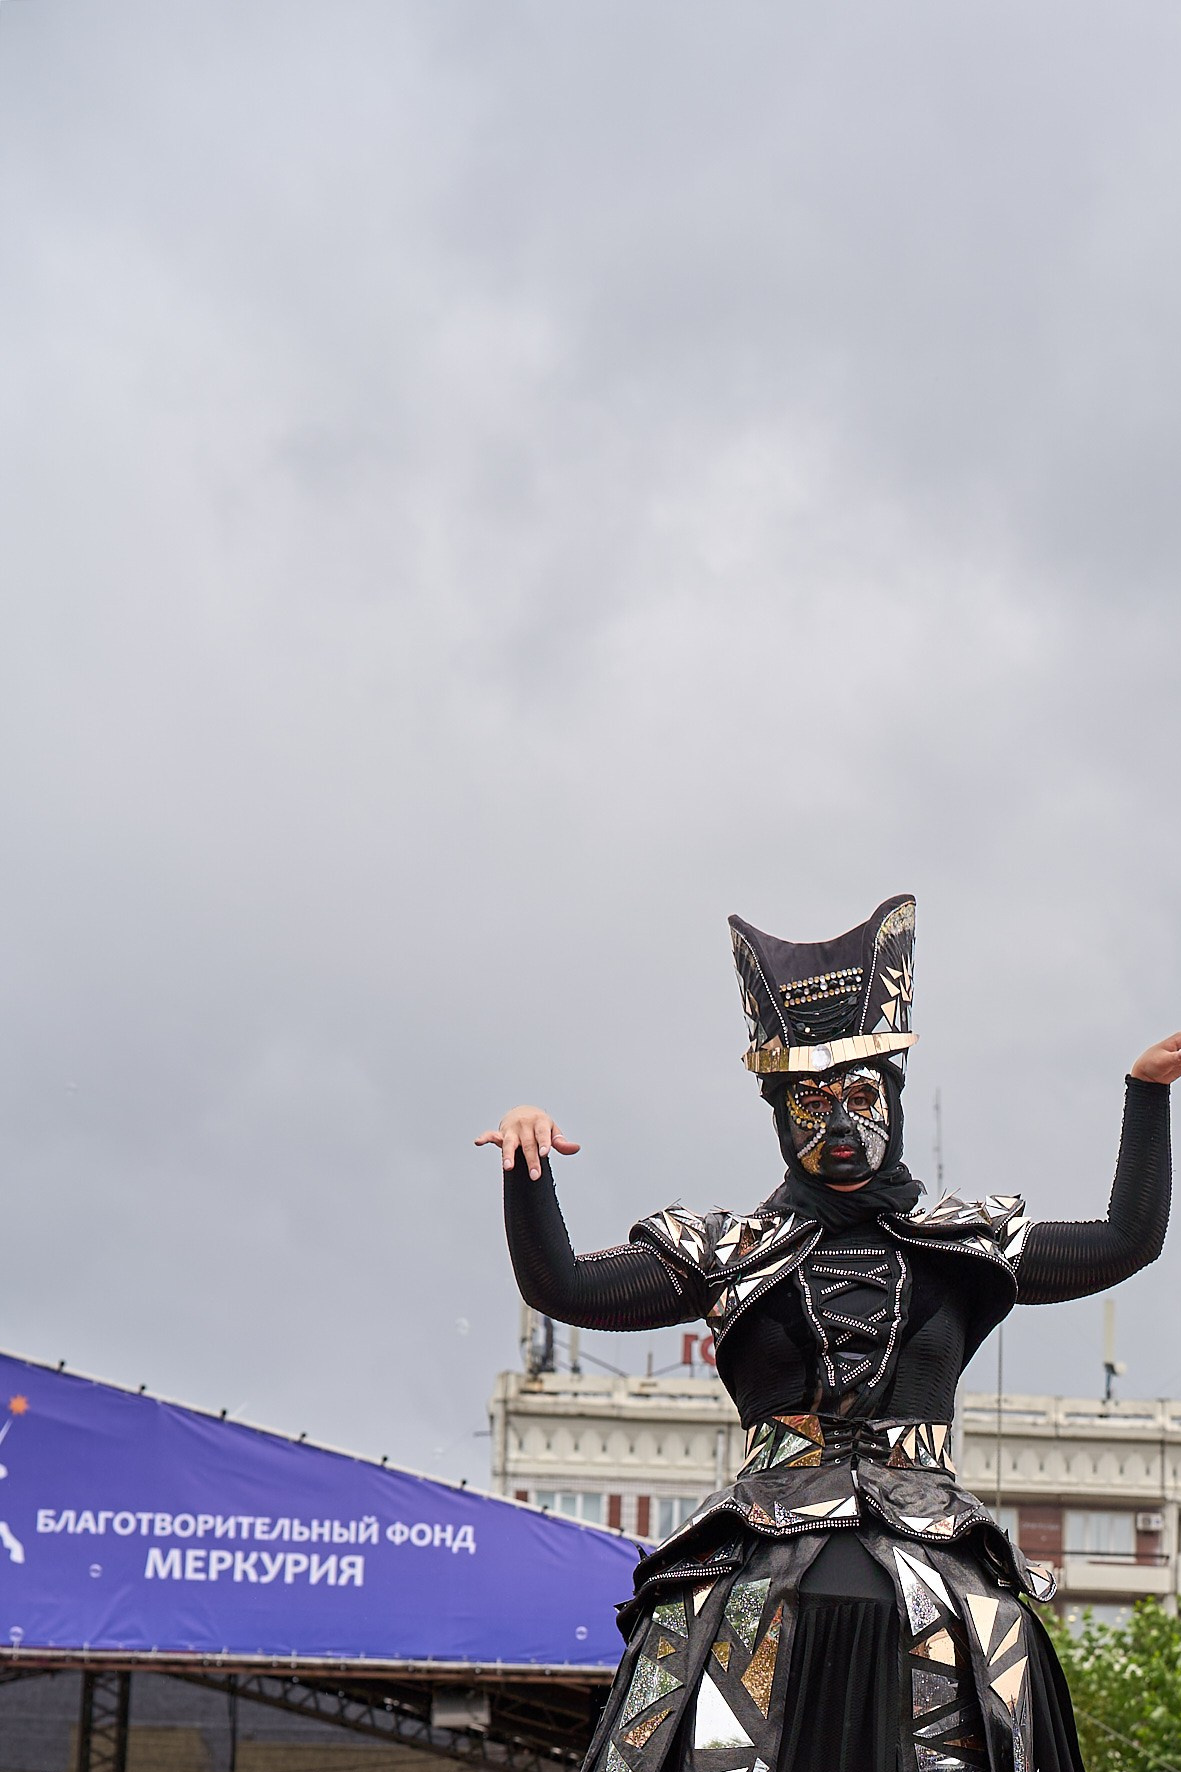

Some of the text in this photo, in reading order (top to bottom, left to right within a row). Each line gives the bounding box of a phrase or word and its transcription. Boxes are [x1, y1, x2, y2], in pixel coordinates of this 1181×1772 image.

[36, 1508, 476, 1554] БЛАГОТВОРИТЕЛЬНЫЙ ФОНД
[144, 1548, 365, 1587] МЕРКУРИЯ
